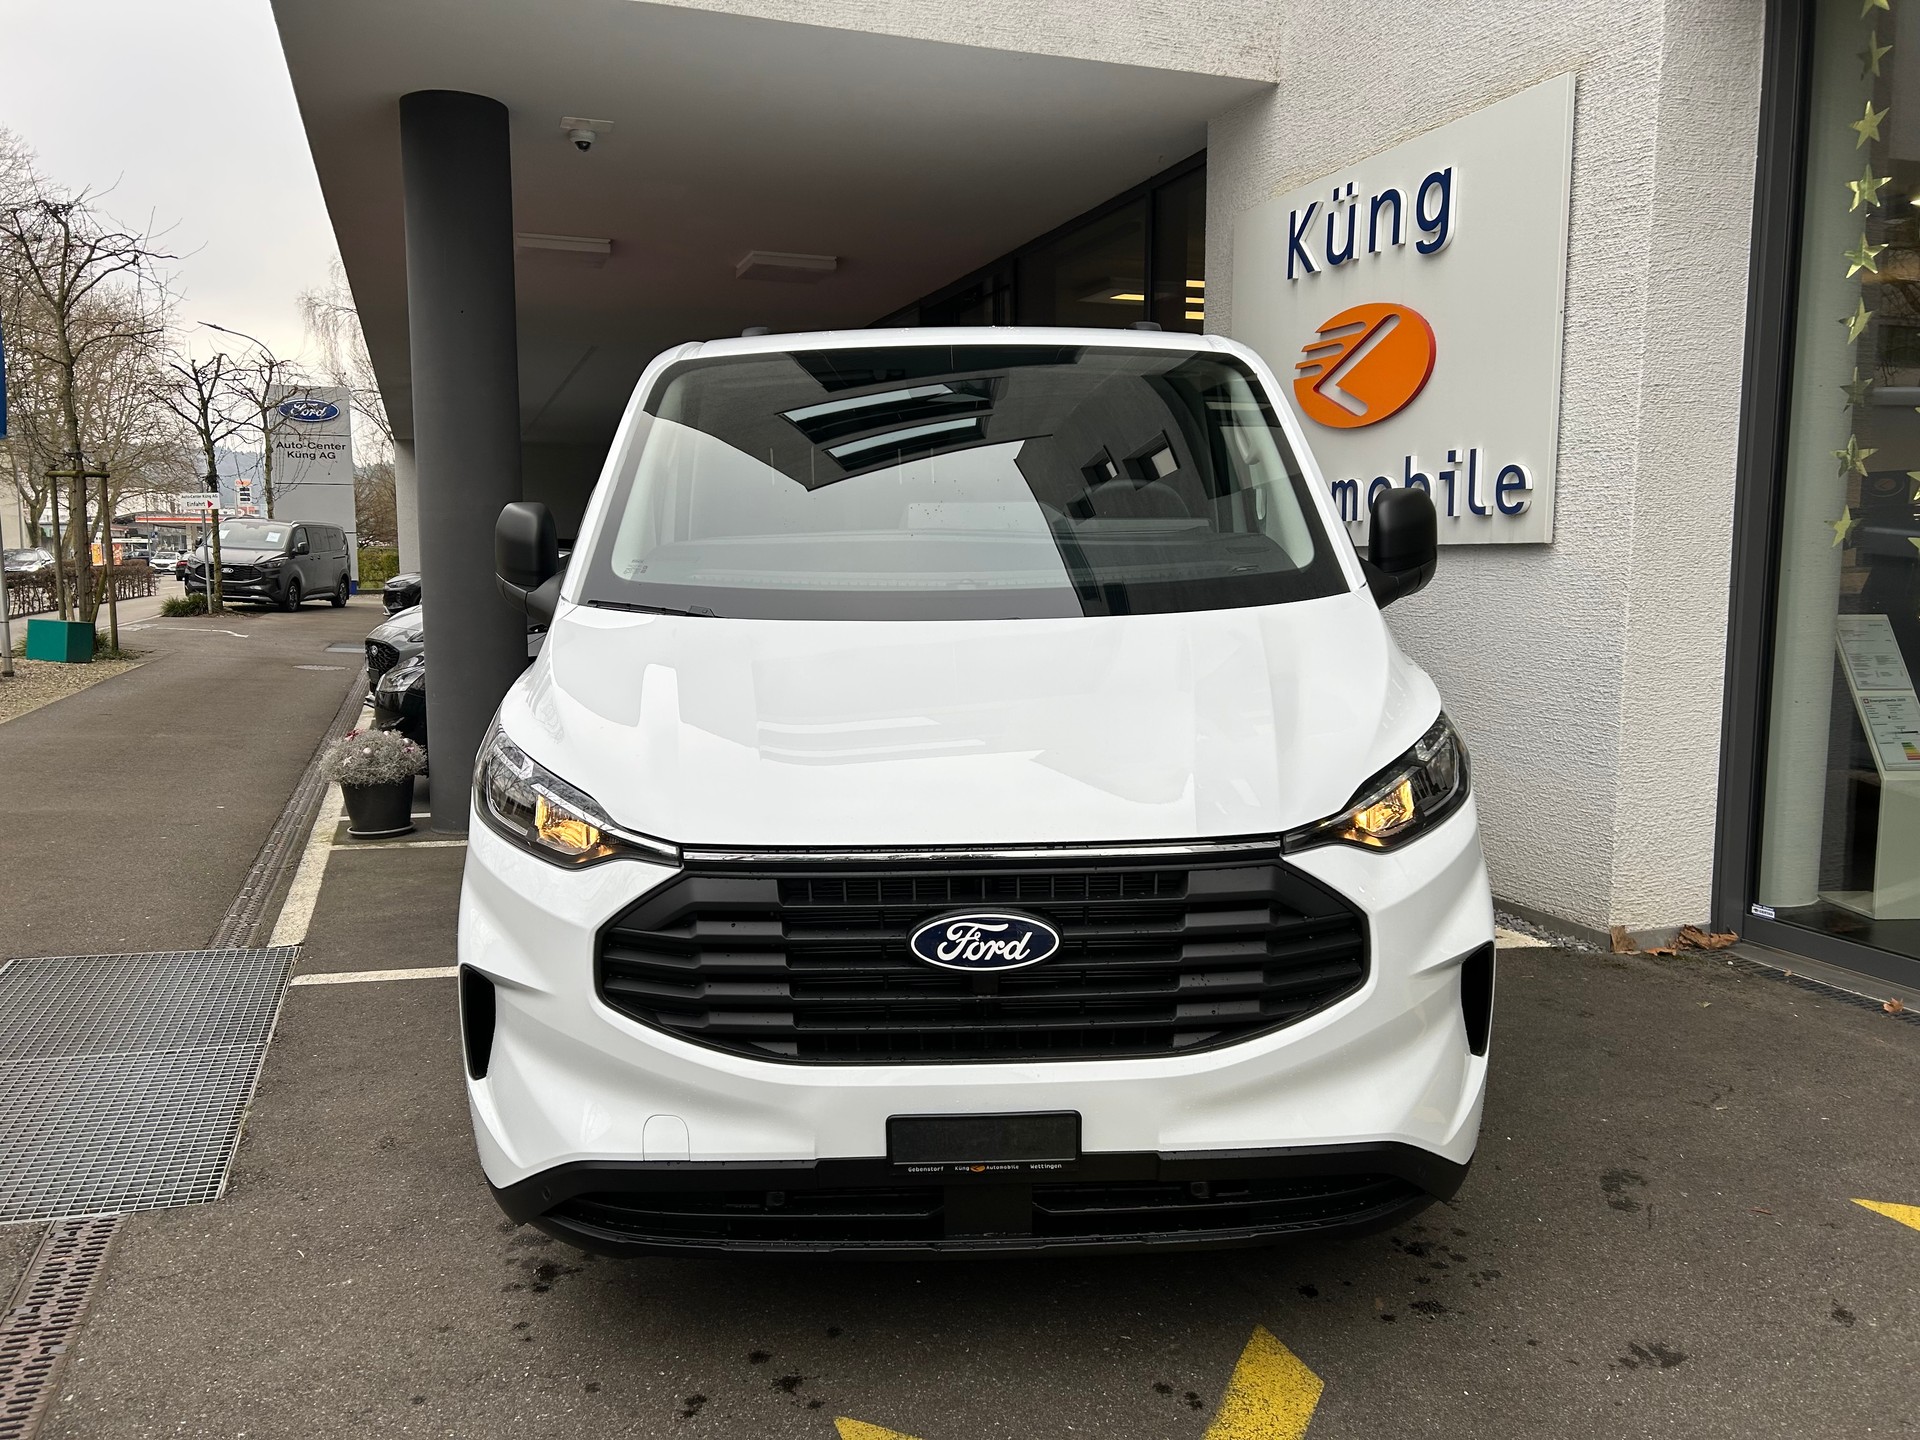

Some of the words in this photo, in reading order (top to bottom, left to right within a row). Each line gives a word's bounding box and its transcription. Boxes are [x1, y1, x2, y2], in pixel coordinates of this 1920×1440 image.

[1287, 166, 1457, 280] Küng
[290, 401, 328, 417] Ford
[276, 441, 346, 451] Auto-Center
[287, 451, 316, 461] Küng
[319, 451, 336, 459] AG
[937, 922, 1033, 961] Ford
